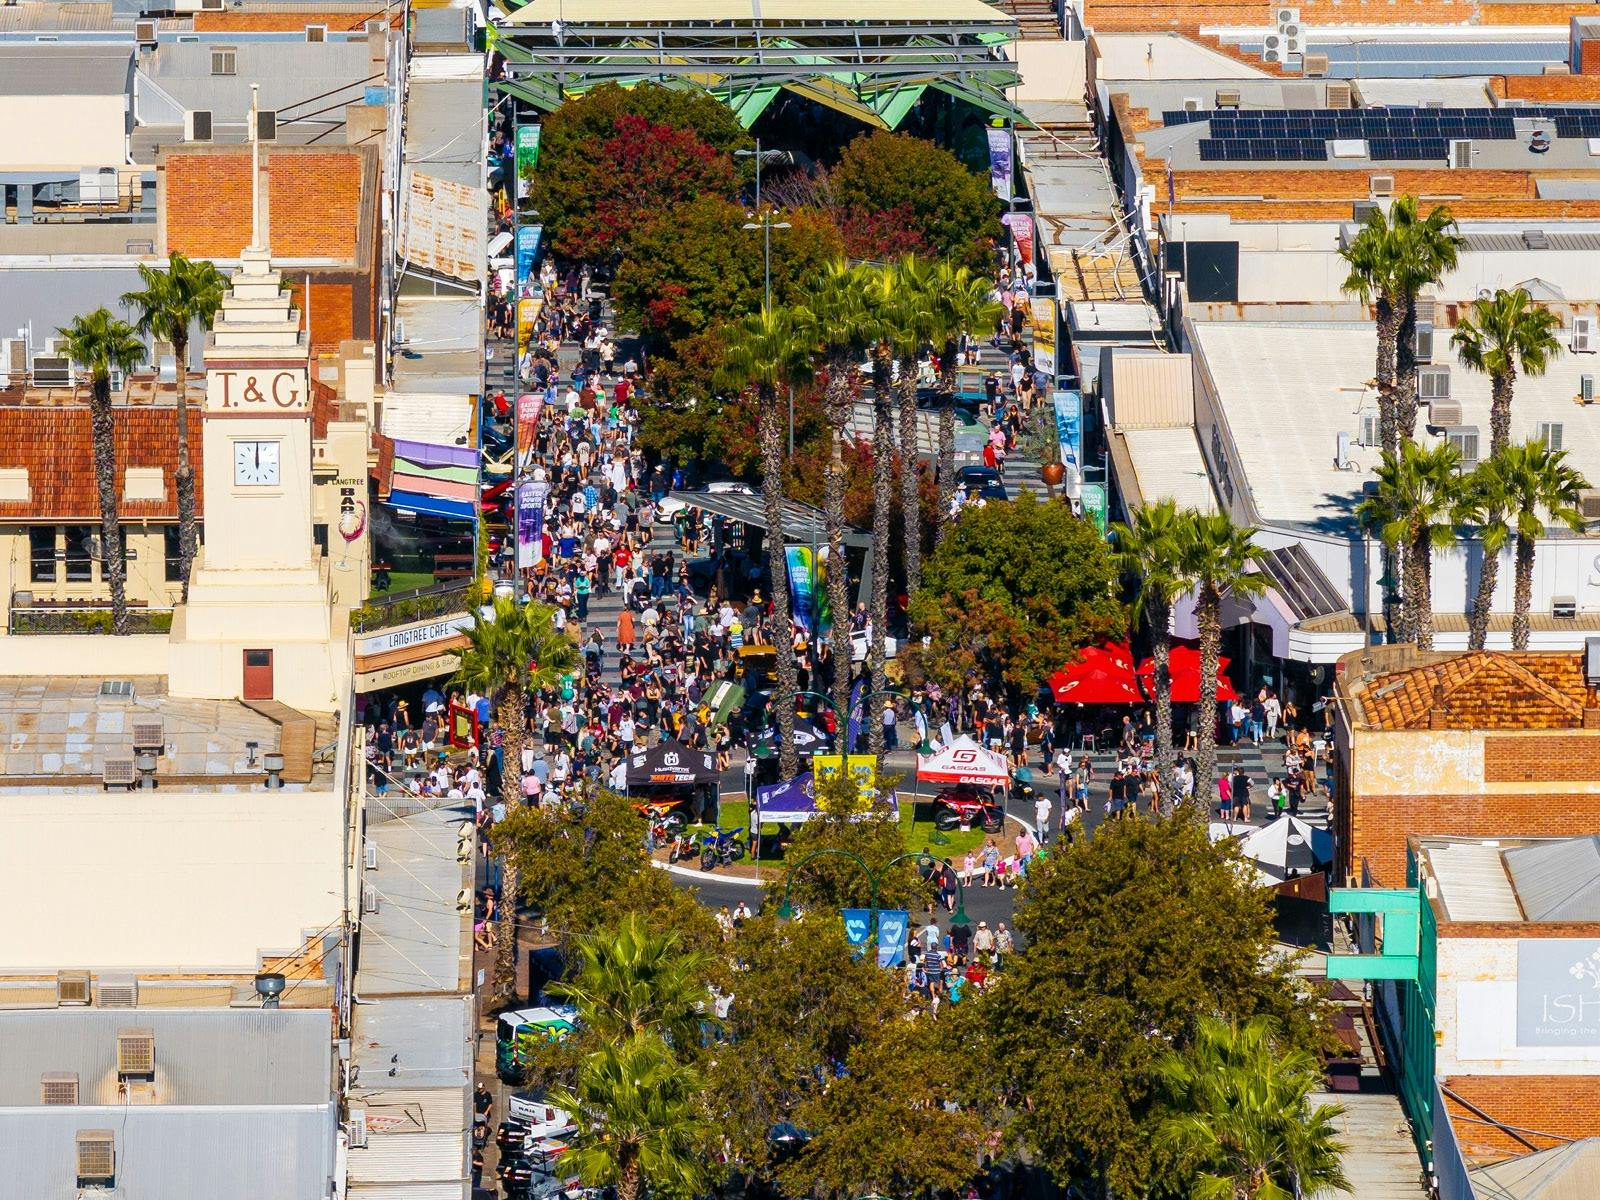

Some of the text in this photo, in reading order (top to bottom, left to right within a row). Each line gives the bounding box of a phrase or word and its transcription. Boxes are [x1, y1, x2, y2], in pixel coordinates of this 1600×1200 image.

[340, 487, 355, 515] BAR
[389, 627, 427, 648] LANGTREE
[429, 622, 450, 639] CAFE
[382, 667, 412, 681] ROOFTOP
[412, 663, 435, 675] DINING
[442, 658, 455, 668] BAR
[941, 765, 987, 773] GASGAS
[959, 776, 1008, 787] GASGAS
[1535, 1026, 1598, 1036] Bringing the
